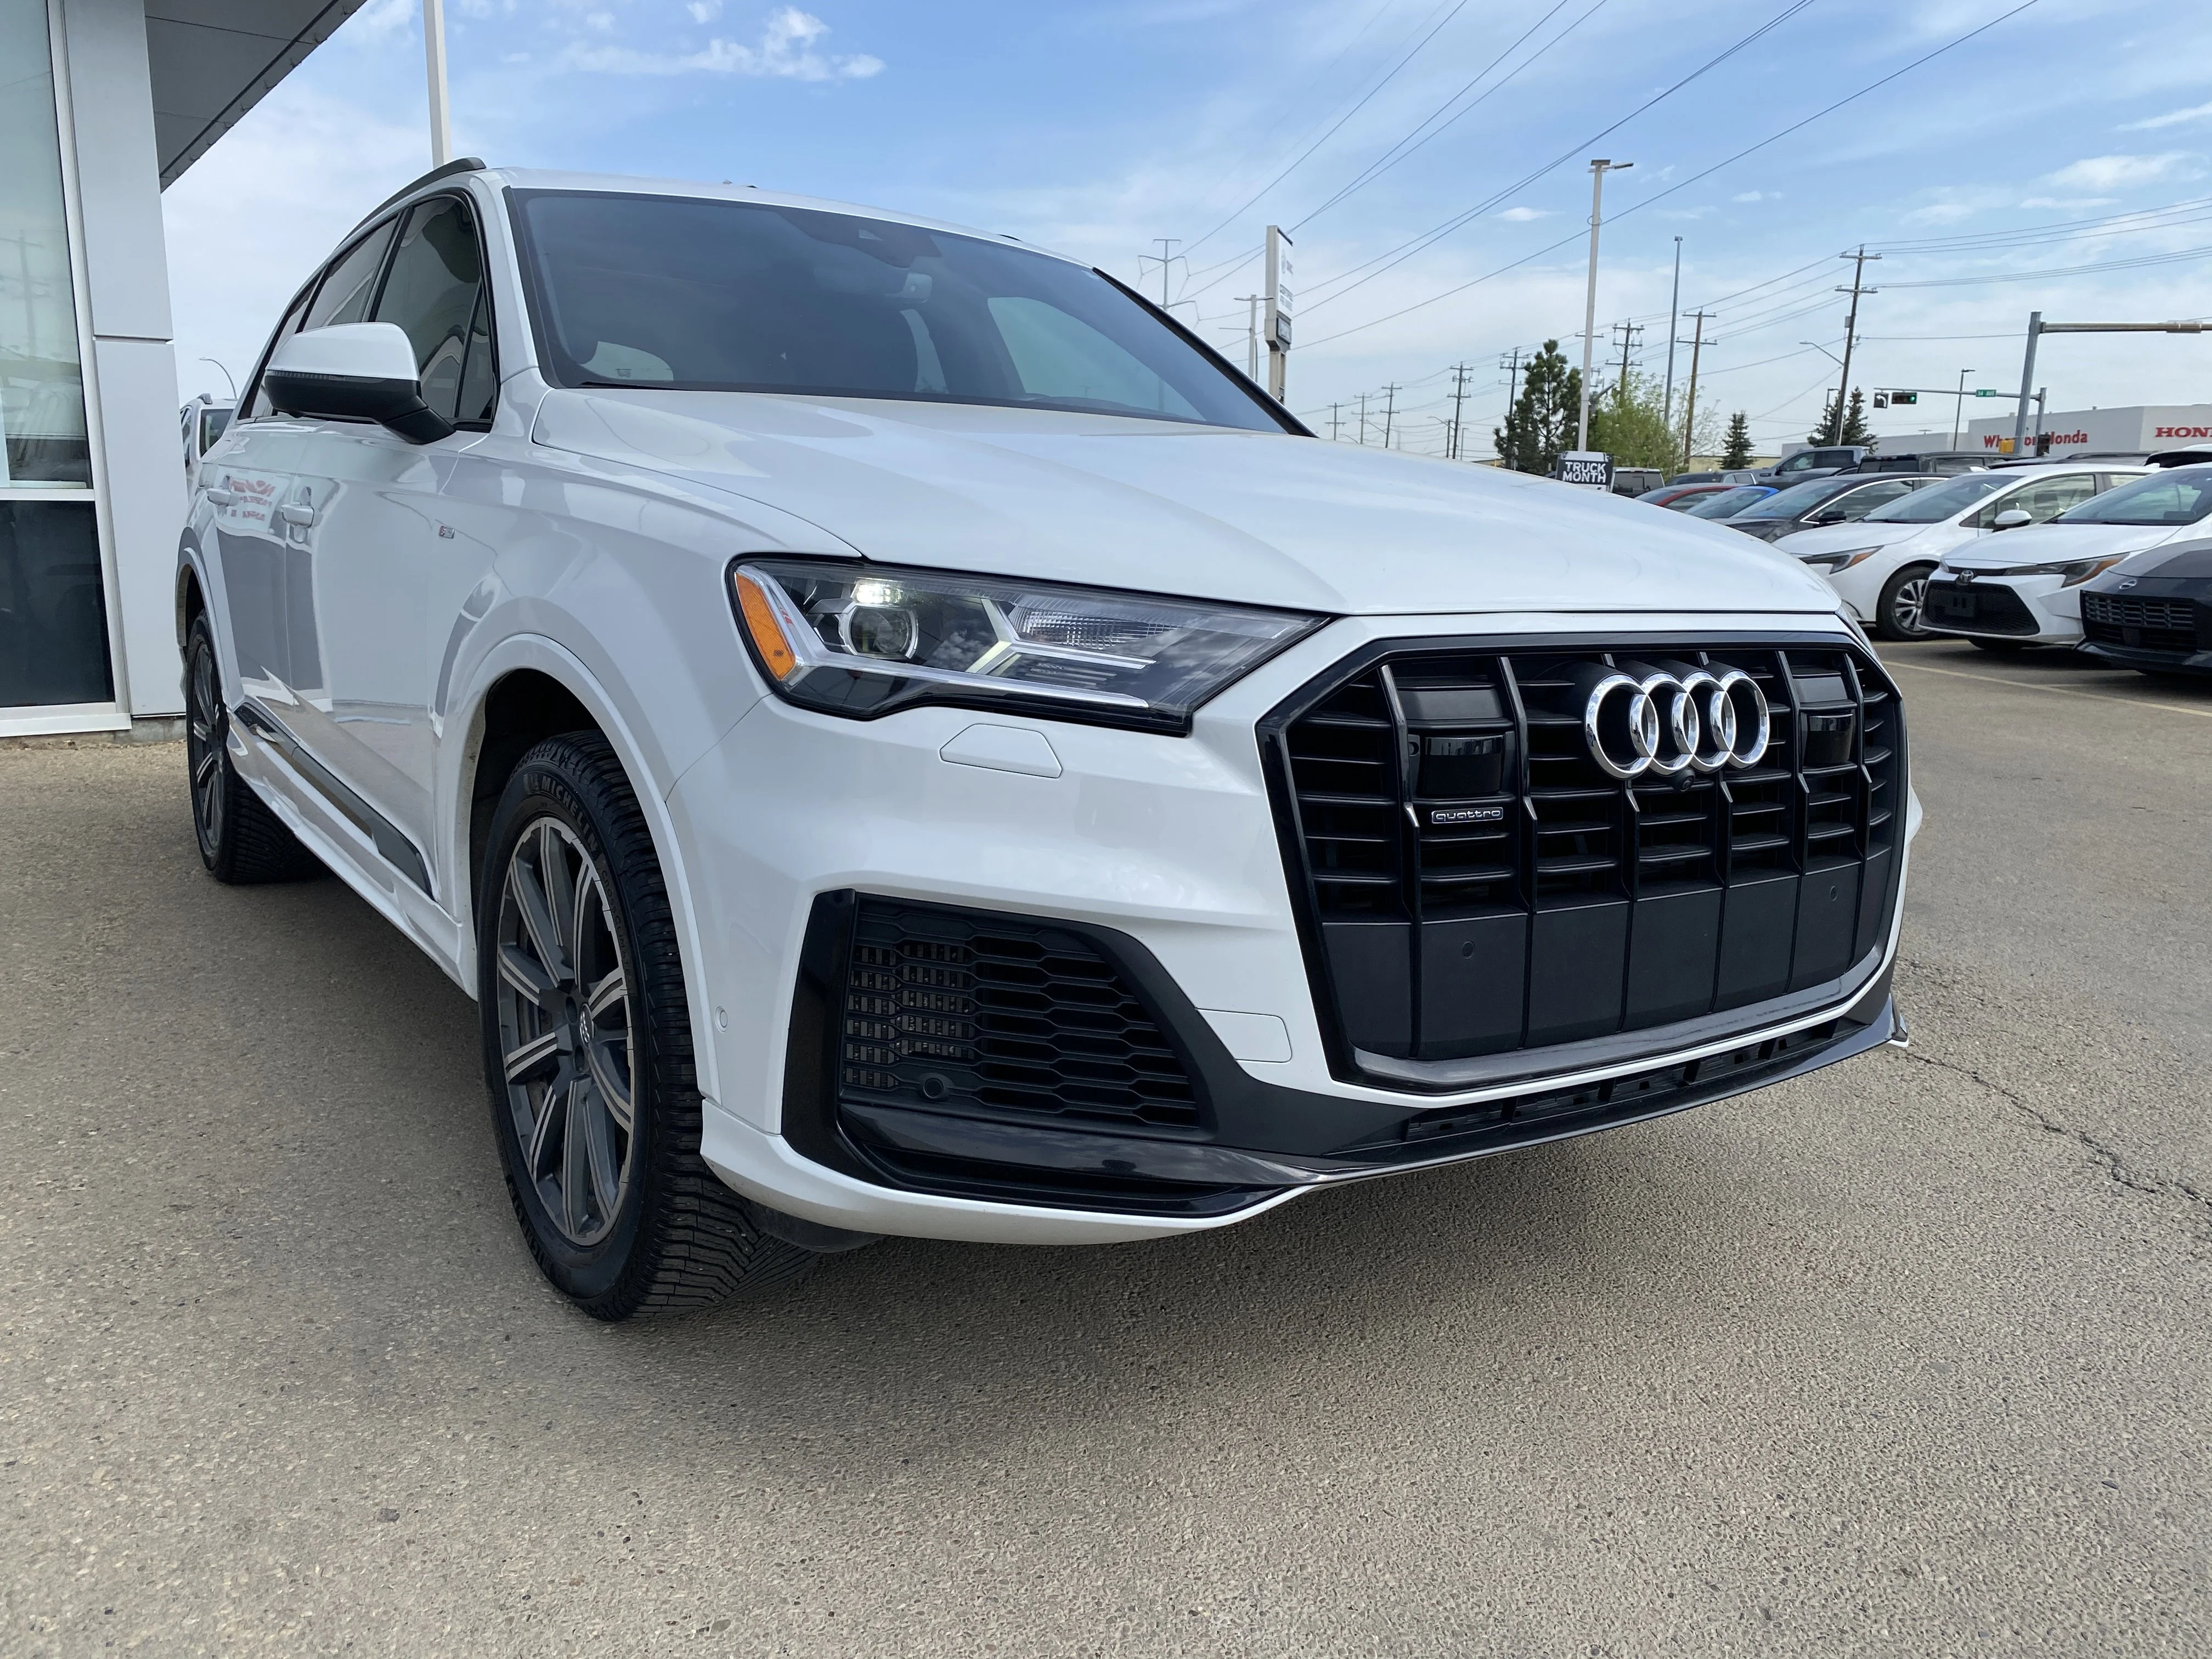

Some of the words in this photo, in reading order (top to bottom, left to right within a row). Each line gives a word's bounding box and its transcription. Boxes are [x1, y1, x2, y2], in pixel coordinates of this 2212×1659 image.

[2155, 427, 2212, 438] HON
[1565, 462, 1606, 473] TRUCK
[1562, 471, 1606, 483] MONTH
[541, 775, 599, 852] MICHELIN
[1436, 810, 1500, 822] quattro
